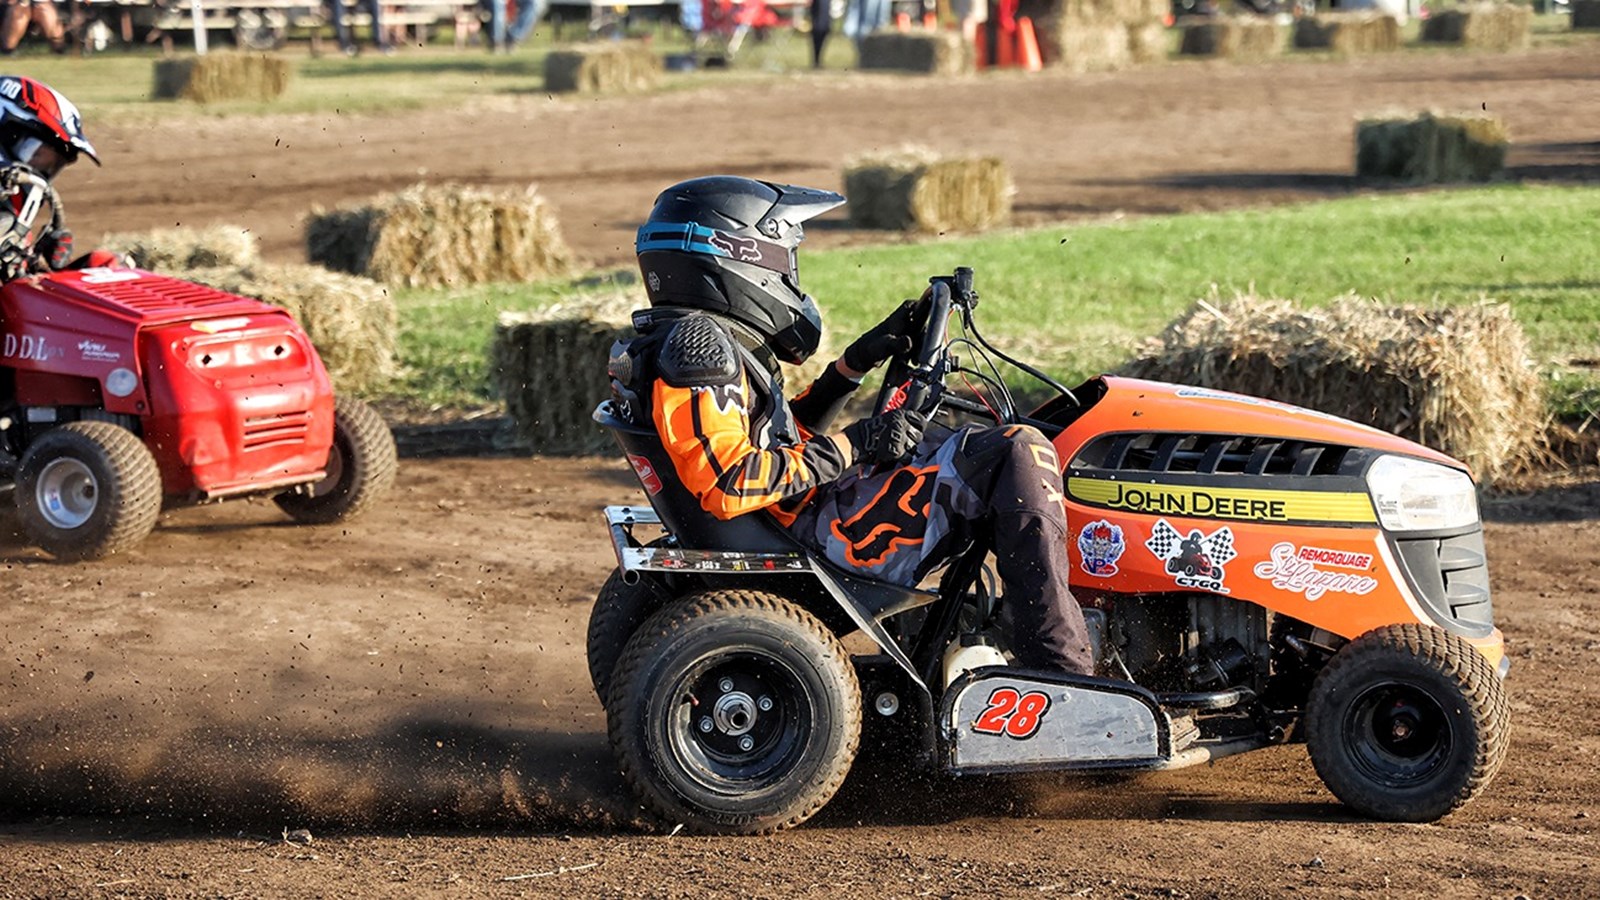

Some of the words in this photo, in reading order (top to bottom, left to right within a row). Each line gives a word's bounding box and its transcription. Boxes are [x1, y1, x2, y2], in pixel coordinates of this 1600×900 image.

[1107, 484, 1186, 512] JOHN
[1192, 490, 1286, 518] DEERE
[1084, 557, 1107, 575] VP
[1299, 547, 1370, 568] REMORQUAGE
[972, 686, 1052, 741] 28
